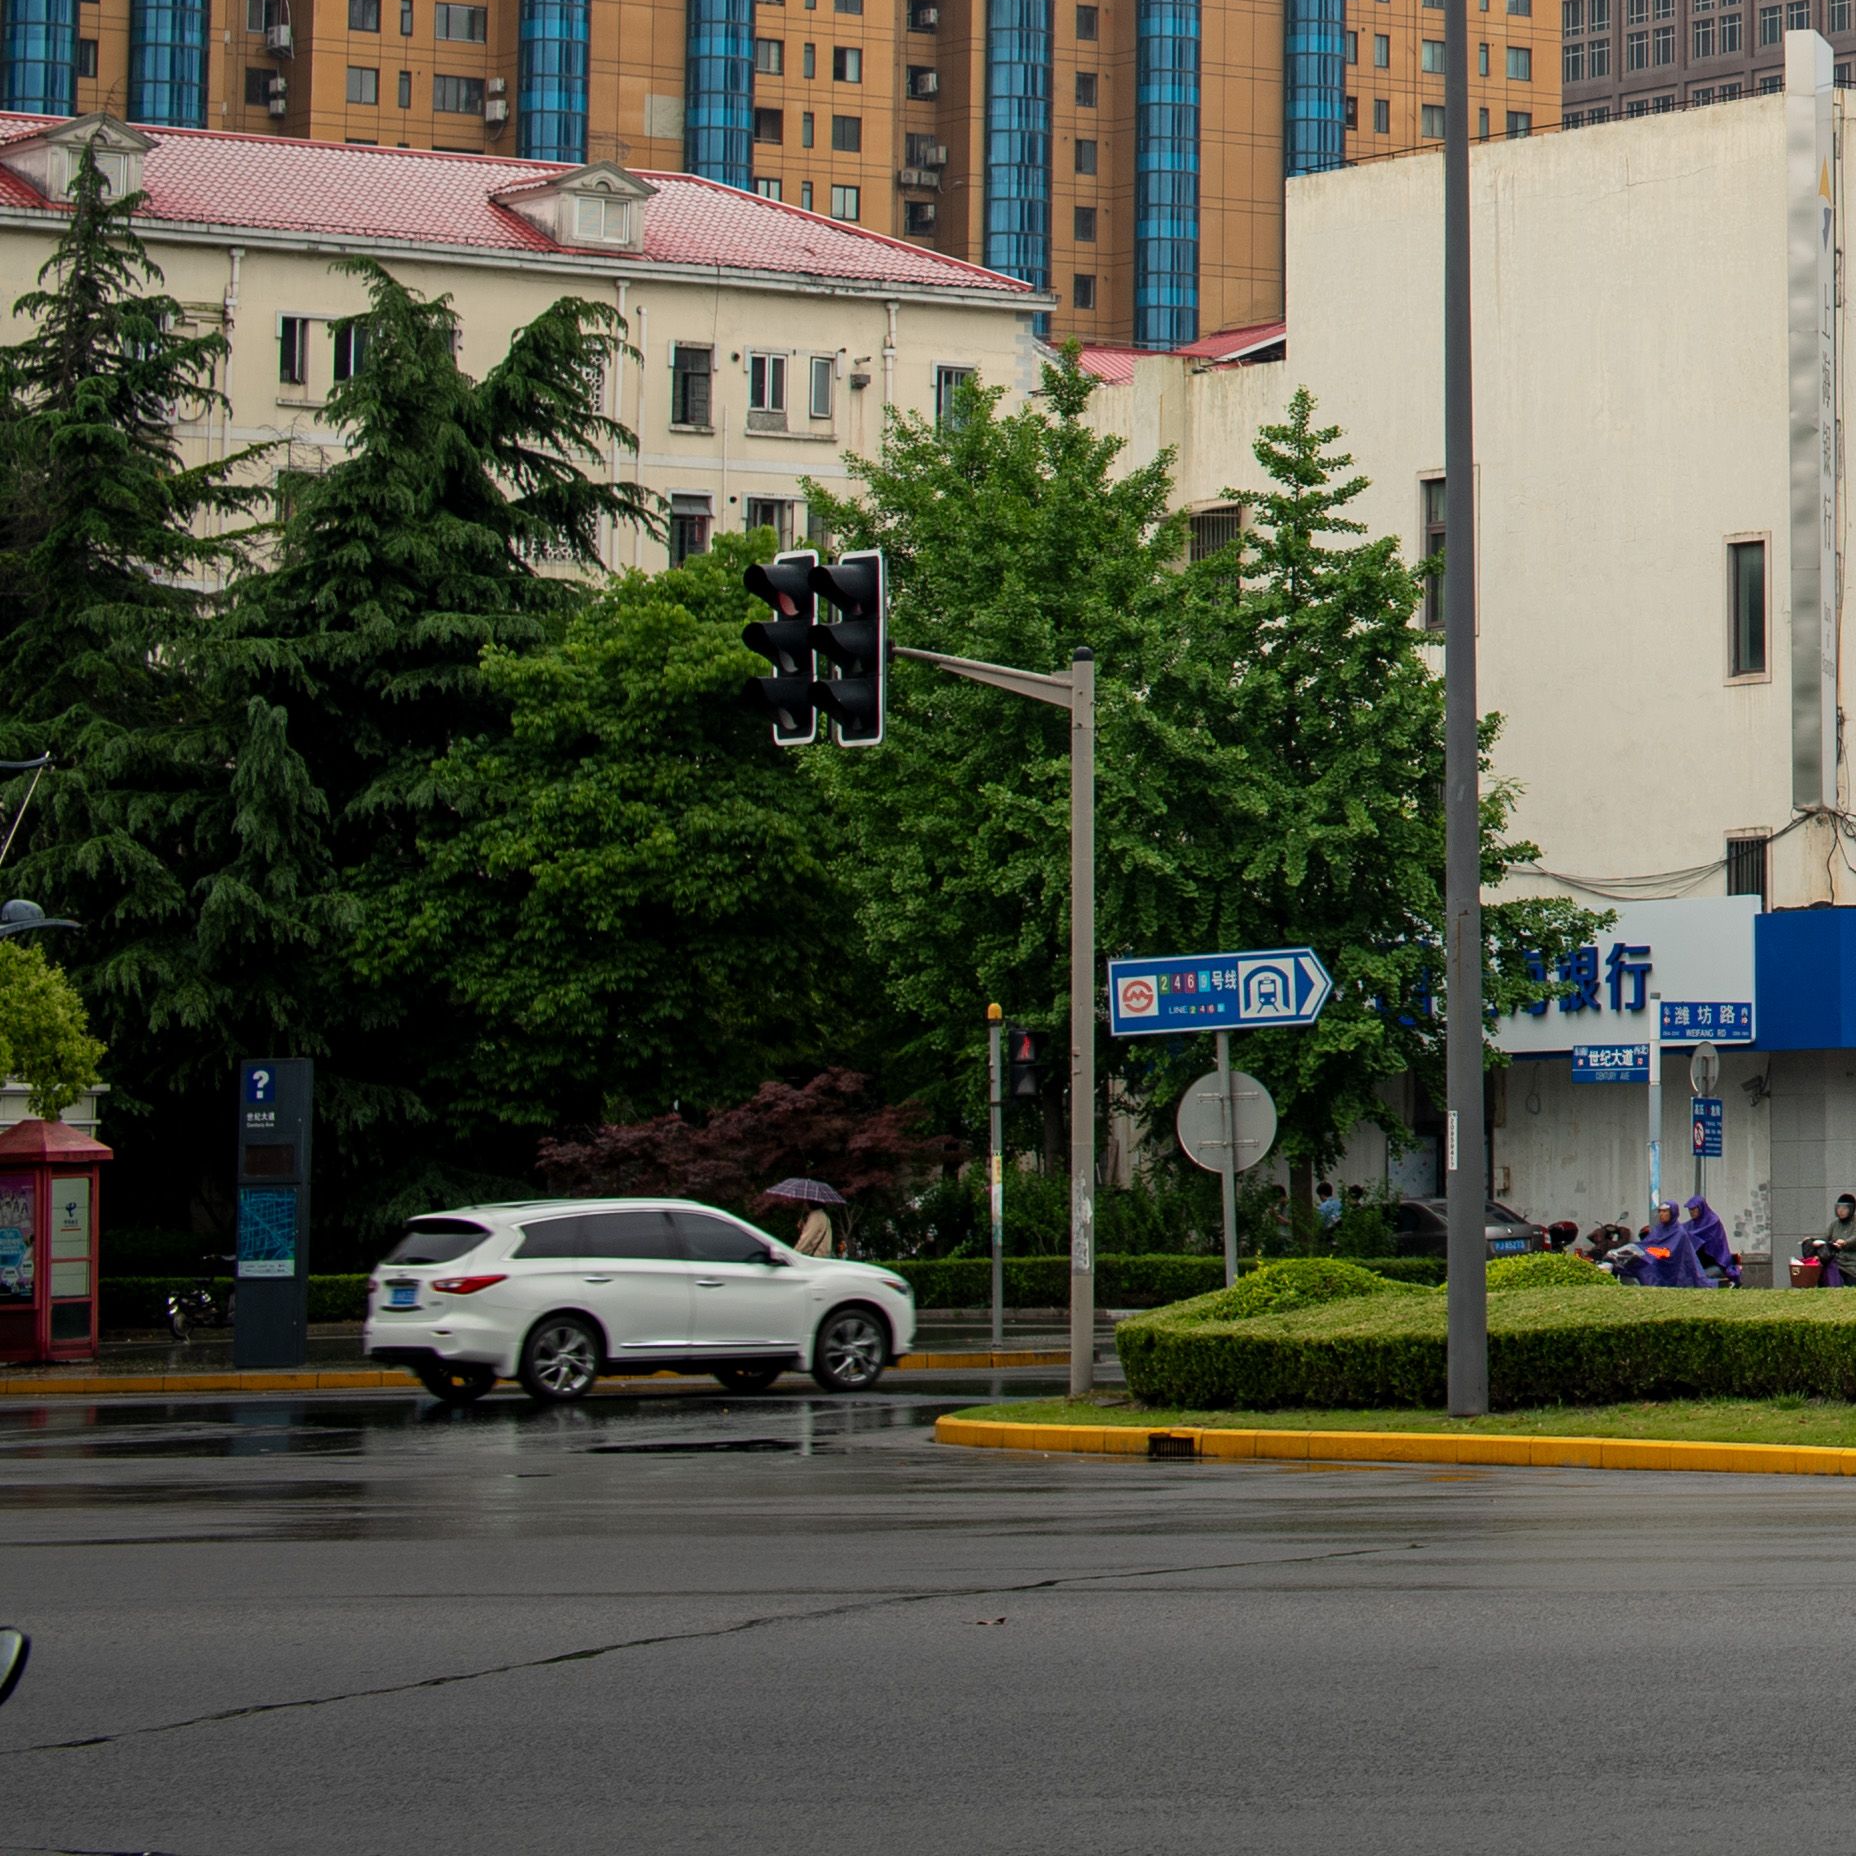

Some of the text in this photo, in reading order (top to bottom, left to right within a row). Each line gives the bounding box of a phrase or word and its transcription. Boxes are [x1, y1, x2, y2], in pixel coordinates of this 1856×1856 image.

[1674, 1004, 1736, 1025] 潍坊路
[1589, 1048, 1634, 1067] 世纪大道
